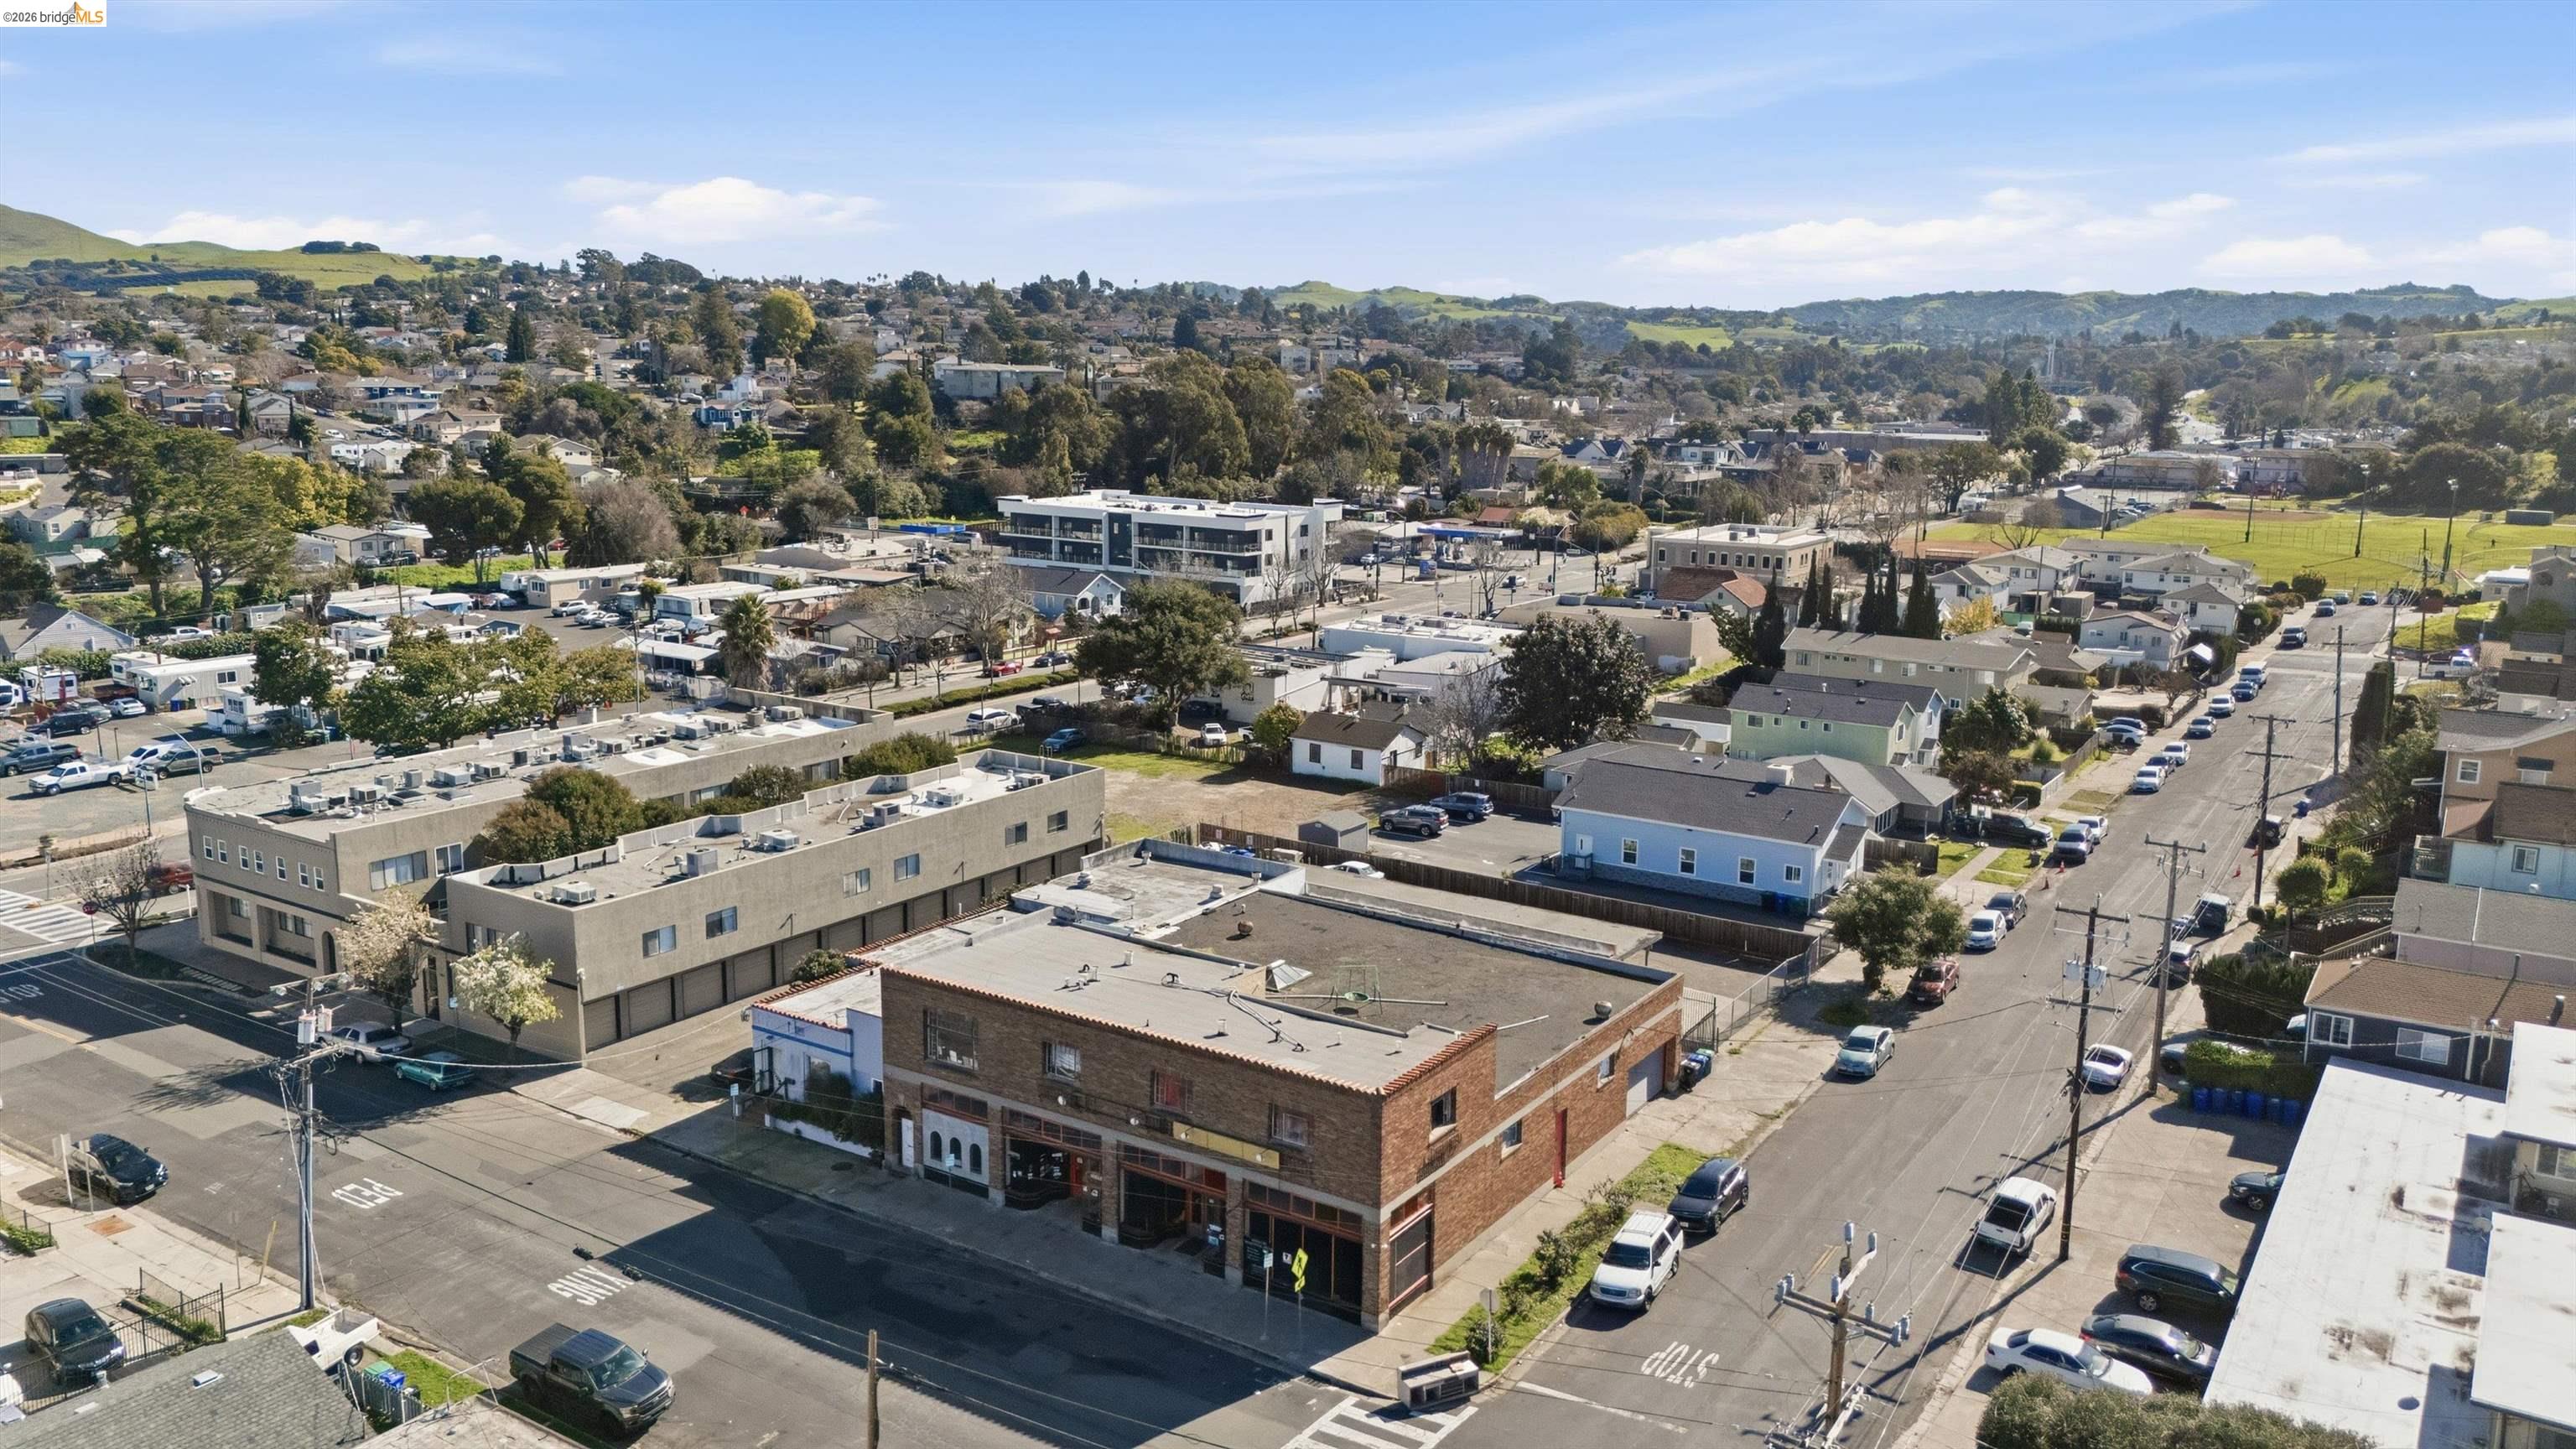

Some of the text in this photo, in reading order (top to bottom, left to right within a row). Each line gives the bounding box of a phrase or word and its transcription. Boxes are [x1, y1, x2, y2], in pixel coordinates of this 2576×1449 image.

[331, 1176, 404, 1209] PED
[548, 1265, 635, 1306] XING
[1641, 1341, 1719, 1389] STOP
